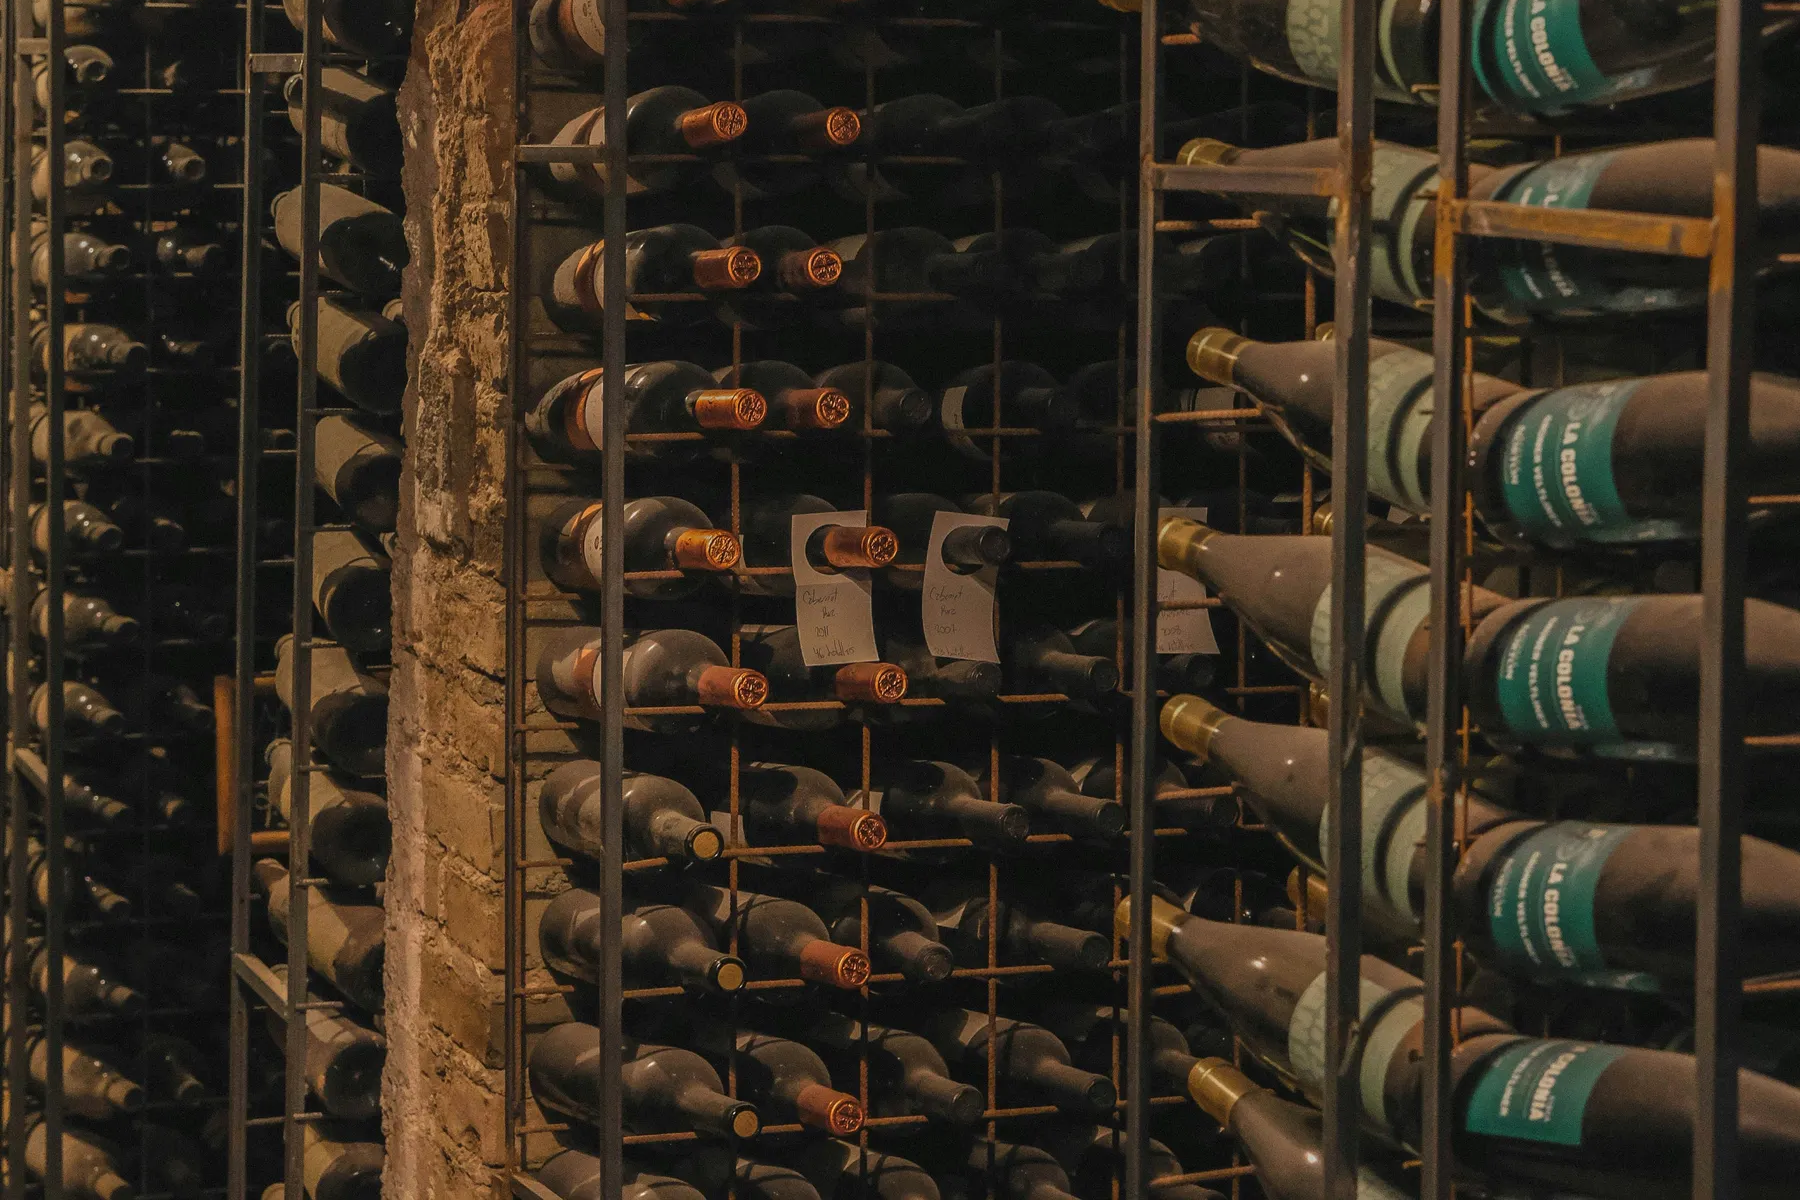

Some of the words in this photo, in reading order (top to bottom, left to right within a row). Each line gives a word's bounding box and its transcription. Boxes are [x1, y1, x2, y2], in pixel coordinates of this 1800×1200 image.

[1529, 15, 1574, 93] COLONIA
[1562, 421, 1582, 446] LA
[1560, 447, 1596, 526] COLONIA
[1563, 624, 1586, 647] LA
[1556, 647, 1584, 731] COLONIA
[1547, 862, 1569, 885] LA
[1543, 887, 1574, 967] COLONIA
[1528, 1052, 1578, 1122] COLONIA
